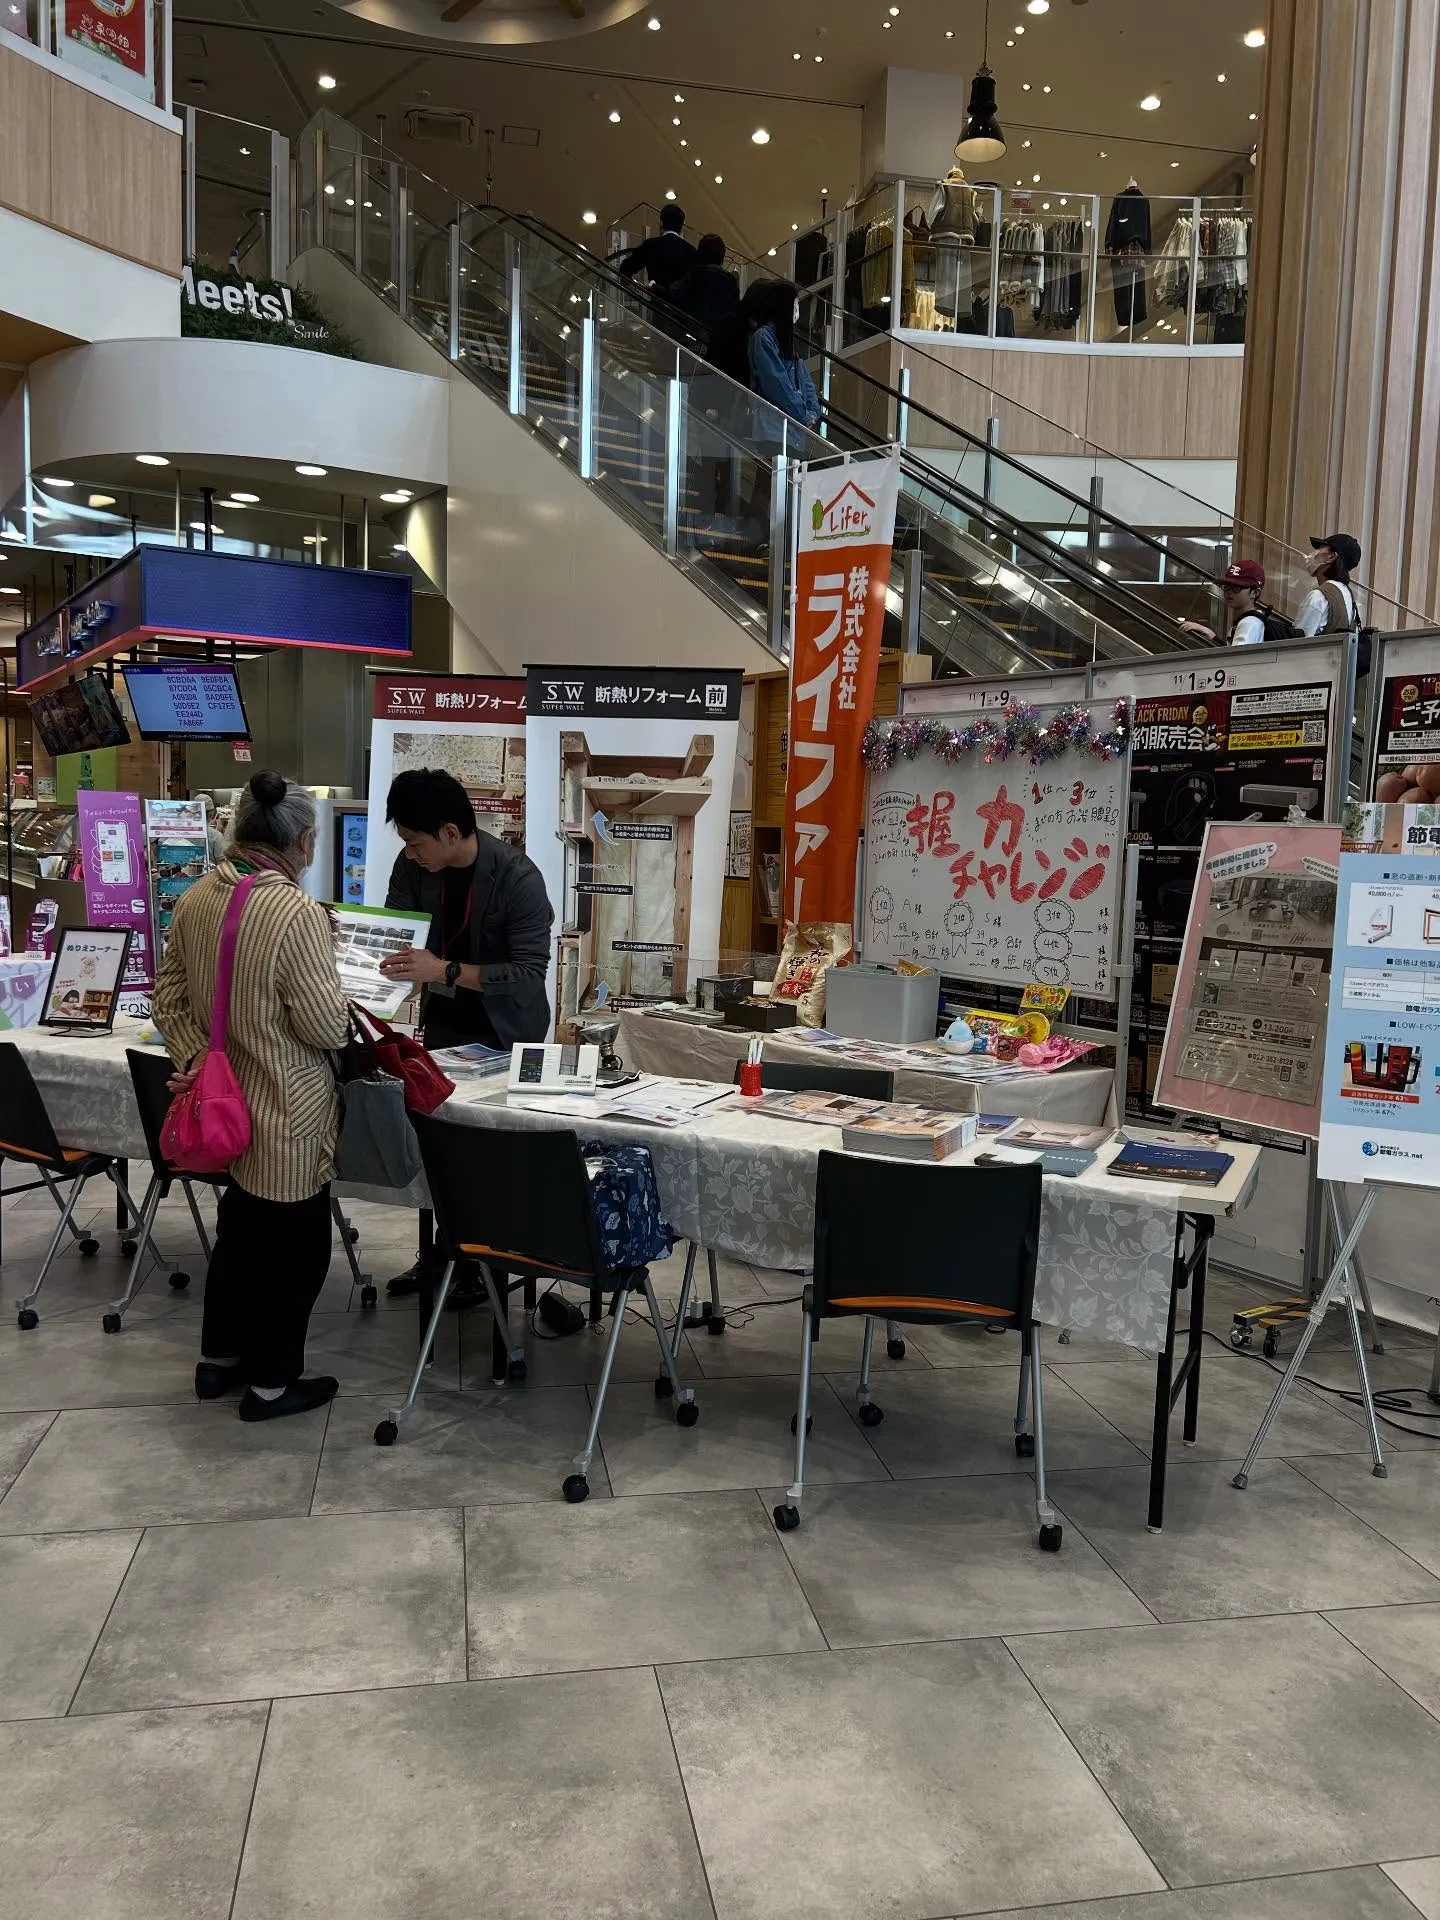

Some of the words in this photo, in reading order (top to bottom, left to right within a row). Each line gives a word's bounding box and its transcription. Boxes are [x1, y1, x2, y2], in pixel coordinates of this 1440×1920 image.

[293, 324, 330, 340] Smile
[830, 505, 868, 533] Lifer
[837, 565, 870, 710] 株式会社
[392, 690, 425, 706] SW
[434, 692, 528, 710] 断熱リフォーム
[546, 684, 583, 701] SW
[595, 686, 702, 704] 断熱リフォーム
[707, 686, 726, 705] 前
[1136, 708, 1156, 724] ACK
[1157, 705, 1190, 723] FRIDAY
[794, 573, 845, 925] ライファー
[905, 783, 1026, 858] 握力
[949, 836, 1111, 905] チャレンジ
[1212, 858, 1267, 879] いただきました
[875, 898, 888, 911] 1位
[952, 912, 967, 926] 2位
[1045, 907, 1062, 922] 3位
[66, 944, 120, 953] ぬりえコーナー
[1042, 936, 1061, 949] 4位
[1042, 965, 1060, 978] 5位
[114, 1001, 151, 1013] EON
